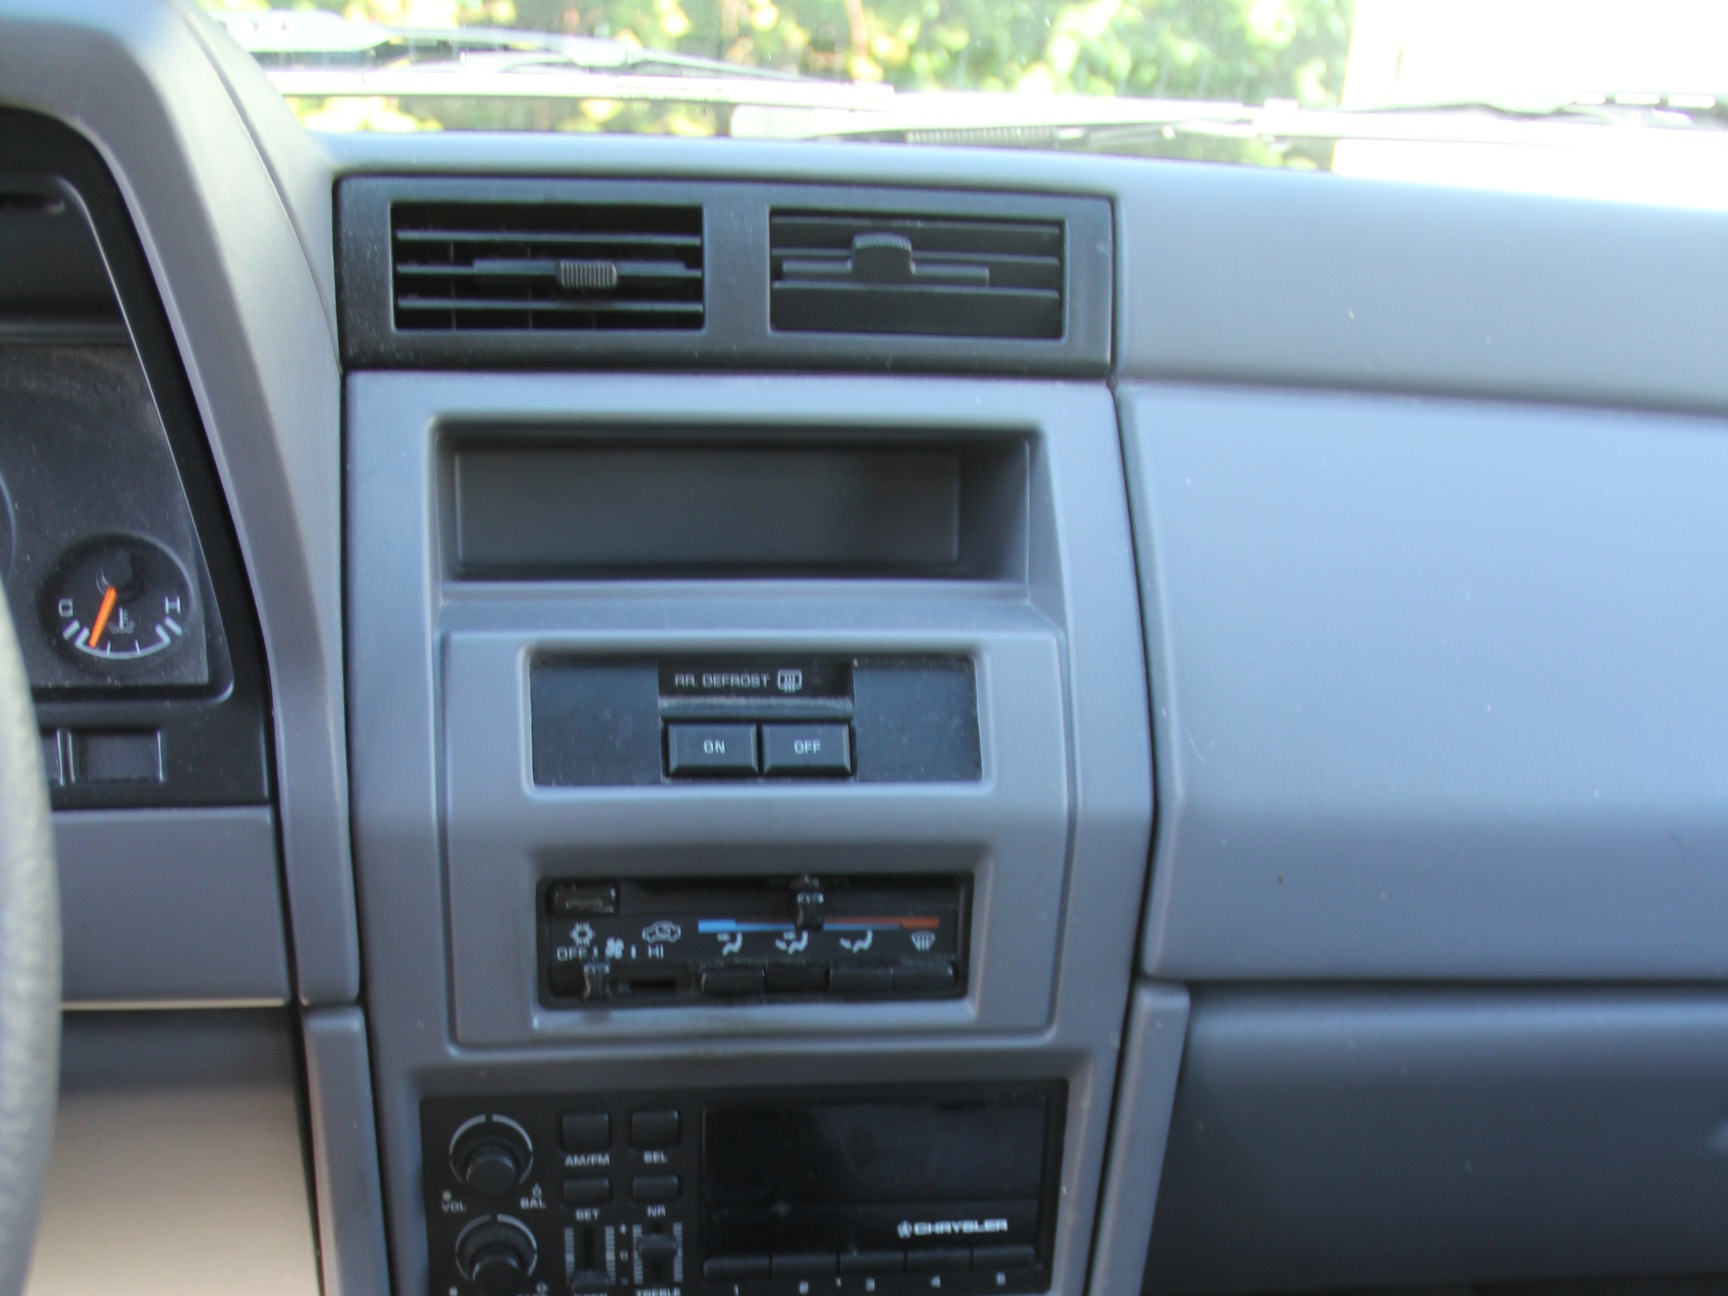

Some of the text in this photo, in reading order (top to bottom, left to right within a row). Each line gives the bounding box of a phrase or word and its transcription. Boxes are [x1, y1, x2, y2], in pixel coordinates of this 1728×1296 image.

[165, 596, 181, 614] H
[702, 672, 771, 688] DEFROST
[703, 739, 726, 755] ON
[793, 739, 822, 755] OFF
[556, 945, 588, 962] OFF
[564, 1152, 611, 1168] AM/FM
[440, 1200, 467, 1213] VOL
[519, 1196, 547, 1211] BAL
[913, 1217, 1008, 1237] CHRYSLER
